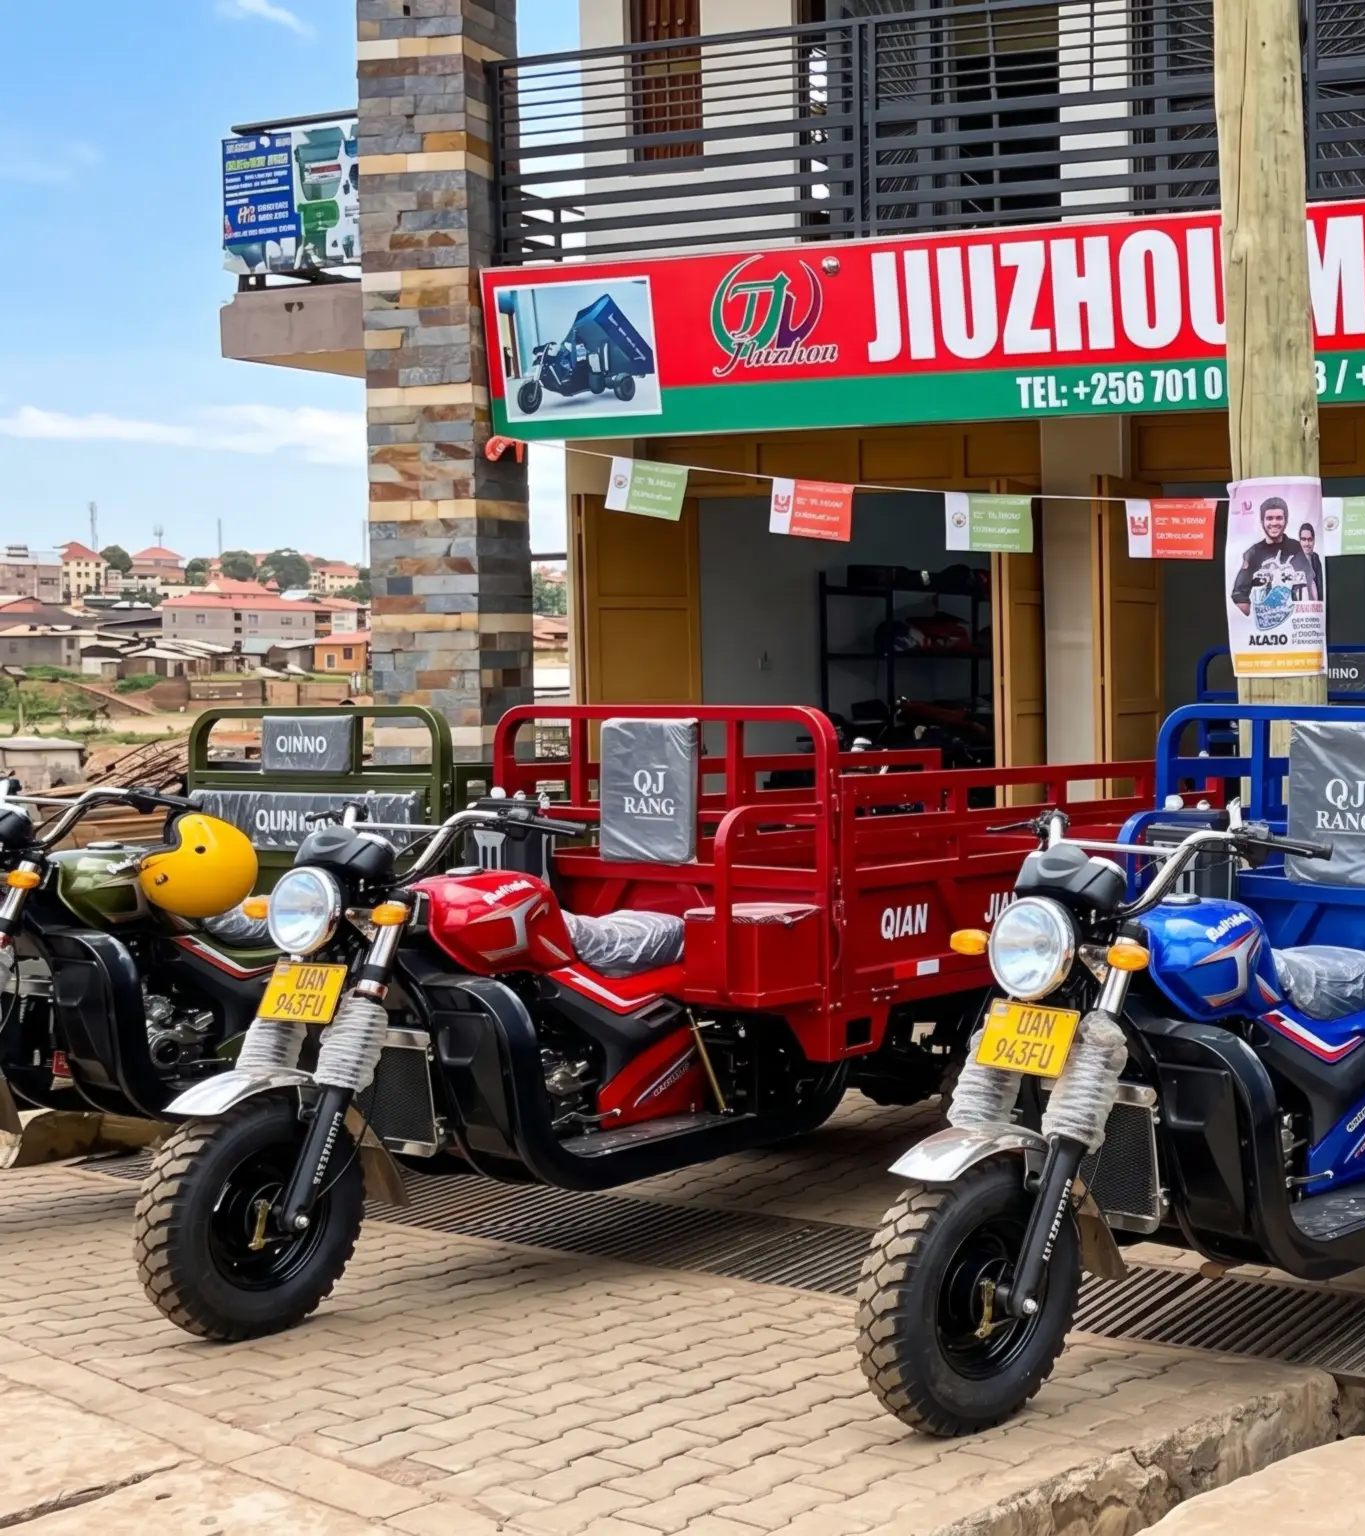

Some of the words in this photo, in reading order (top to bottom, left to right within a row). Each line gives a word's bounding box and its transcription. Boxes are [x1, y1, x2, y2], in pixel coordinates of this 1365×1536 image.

[1016, 375, 1068, 409] TEL:
[1073, 370, 1145, 405] +256
[1150, 368, 1198, 403] 701
[633, 769, 667, 797] QJ
[623, 796, 676, 816] RANG
[881, 903, 929, 942] QIAN
[295, 967, 330, 992] UAN
[272, 992, 327, 1017] 943FU
[1016, 1010, 1058, 1039] UAN
[992, 1037, 1055, 1070] 943FU
